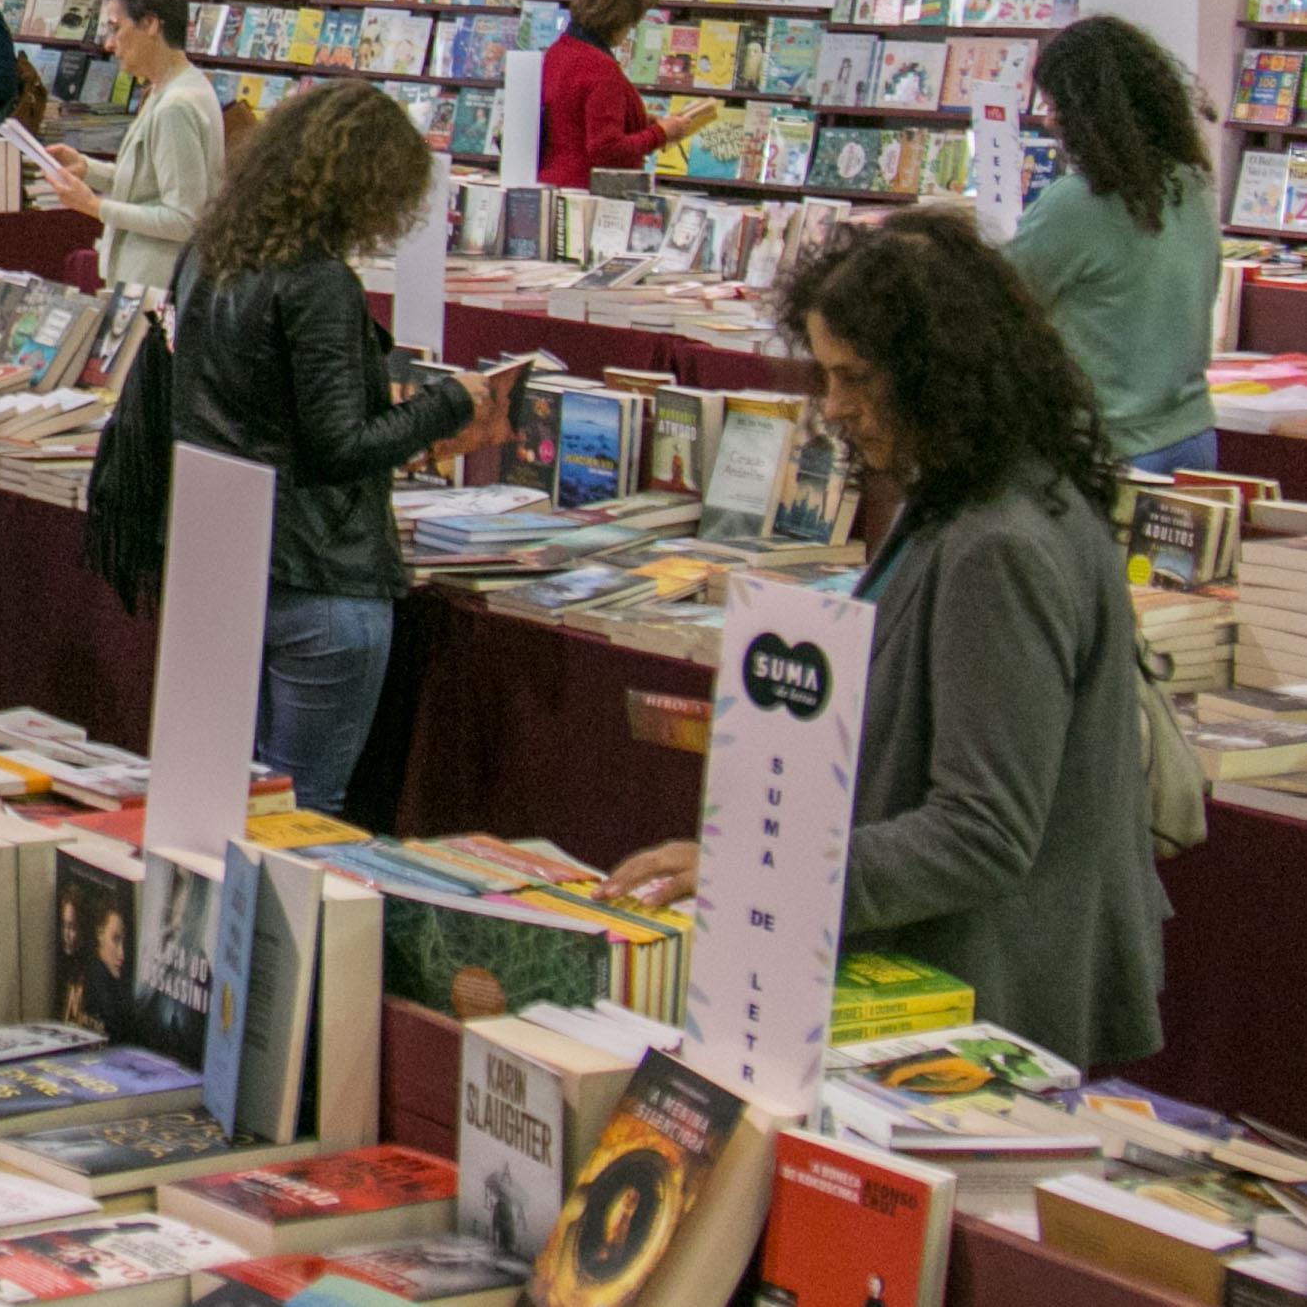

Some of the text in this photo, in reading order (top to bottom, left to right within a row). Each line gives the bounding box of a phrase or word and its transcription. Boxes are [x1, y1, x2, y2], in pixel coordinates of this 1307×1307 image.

[993, 138, 1003, 204] LEYA
[1144, 522, 1195, 548] ADULTOS
[753, 653, 819, 693] SUMA
[761, 757, 784, 869] SUMA
[750, 908, 776, 933] DE
[486, 1052, 528, 1106] KARIN
[466, 1082, 553, 1169] SLAUGHTER
